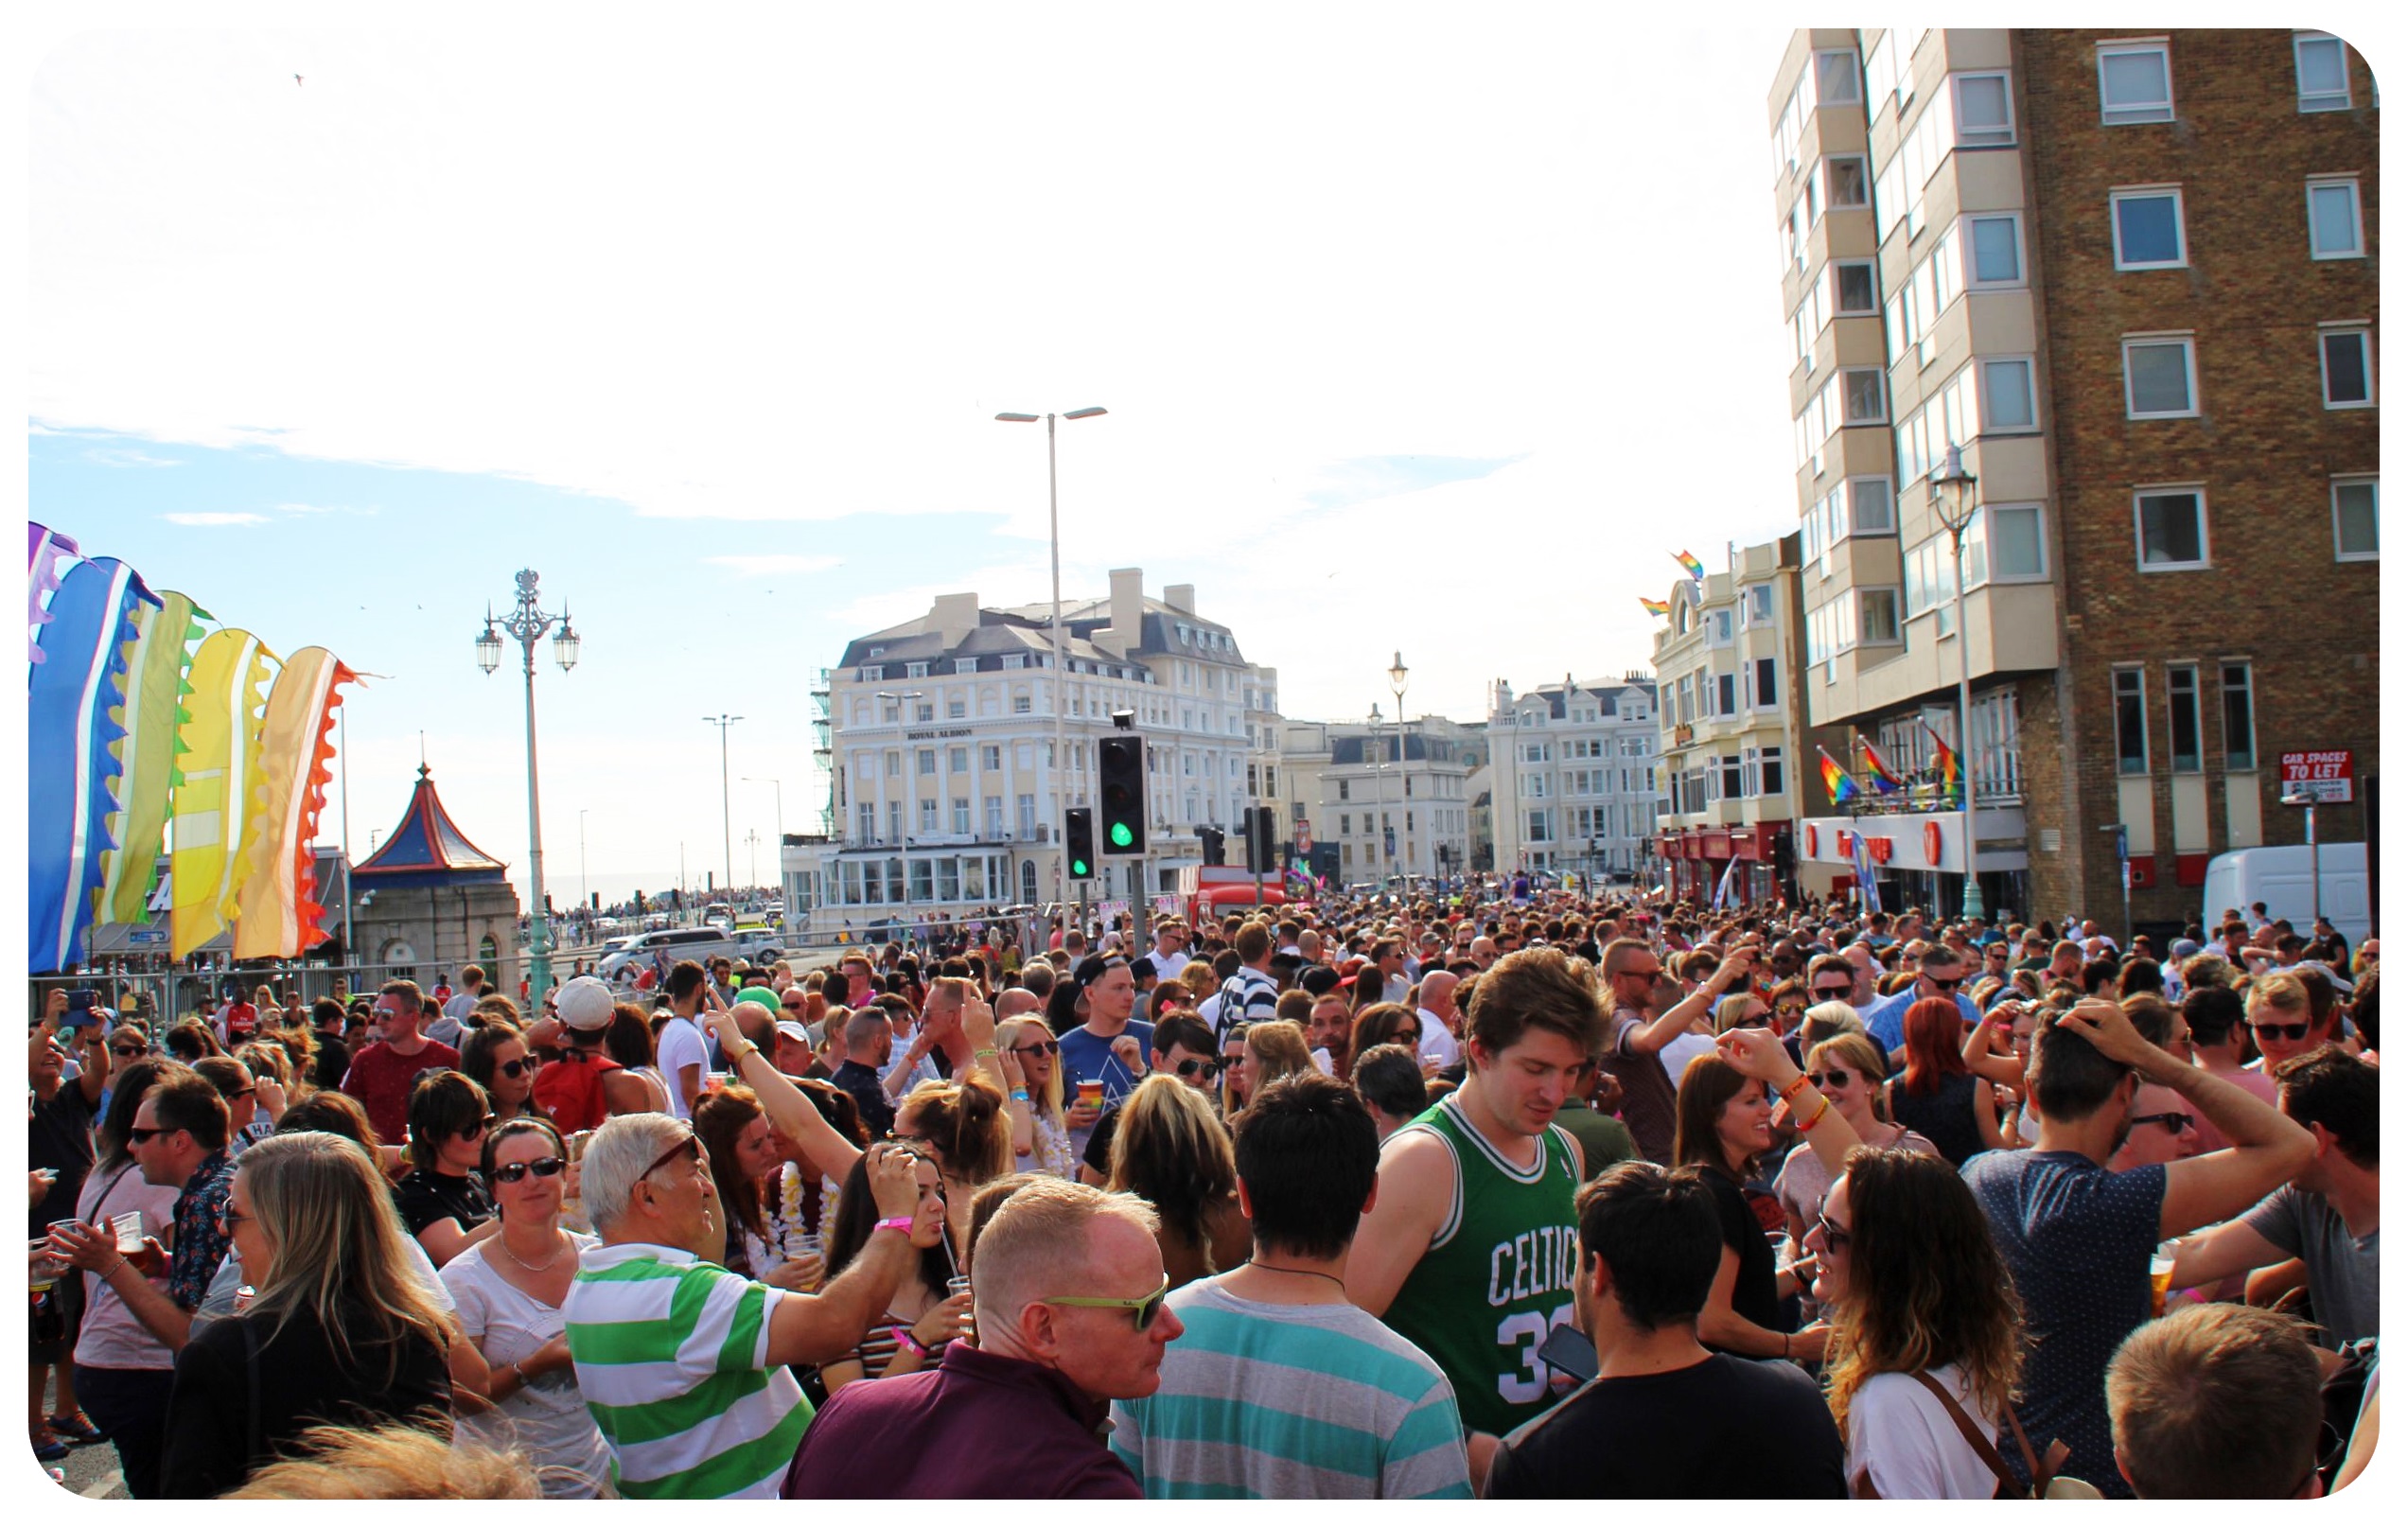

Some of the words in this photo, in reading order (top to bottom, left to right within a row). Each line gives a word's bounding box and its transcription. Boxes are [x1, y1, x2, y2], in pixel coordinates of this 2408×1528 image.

[907, 730, 935, 740] ROYAL
[939, 729, 972, 738] ALBION
[2282, 753, 2304, 764] CAR
[2307, 751, 2347, 764] SPACES
[2289, 764, 2309, 780] TO
[2313, 764, 2342, 778] LET
[1488, 1225, 1578, 1307] CELTIC
